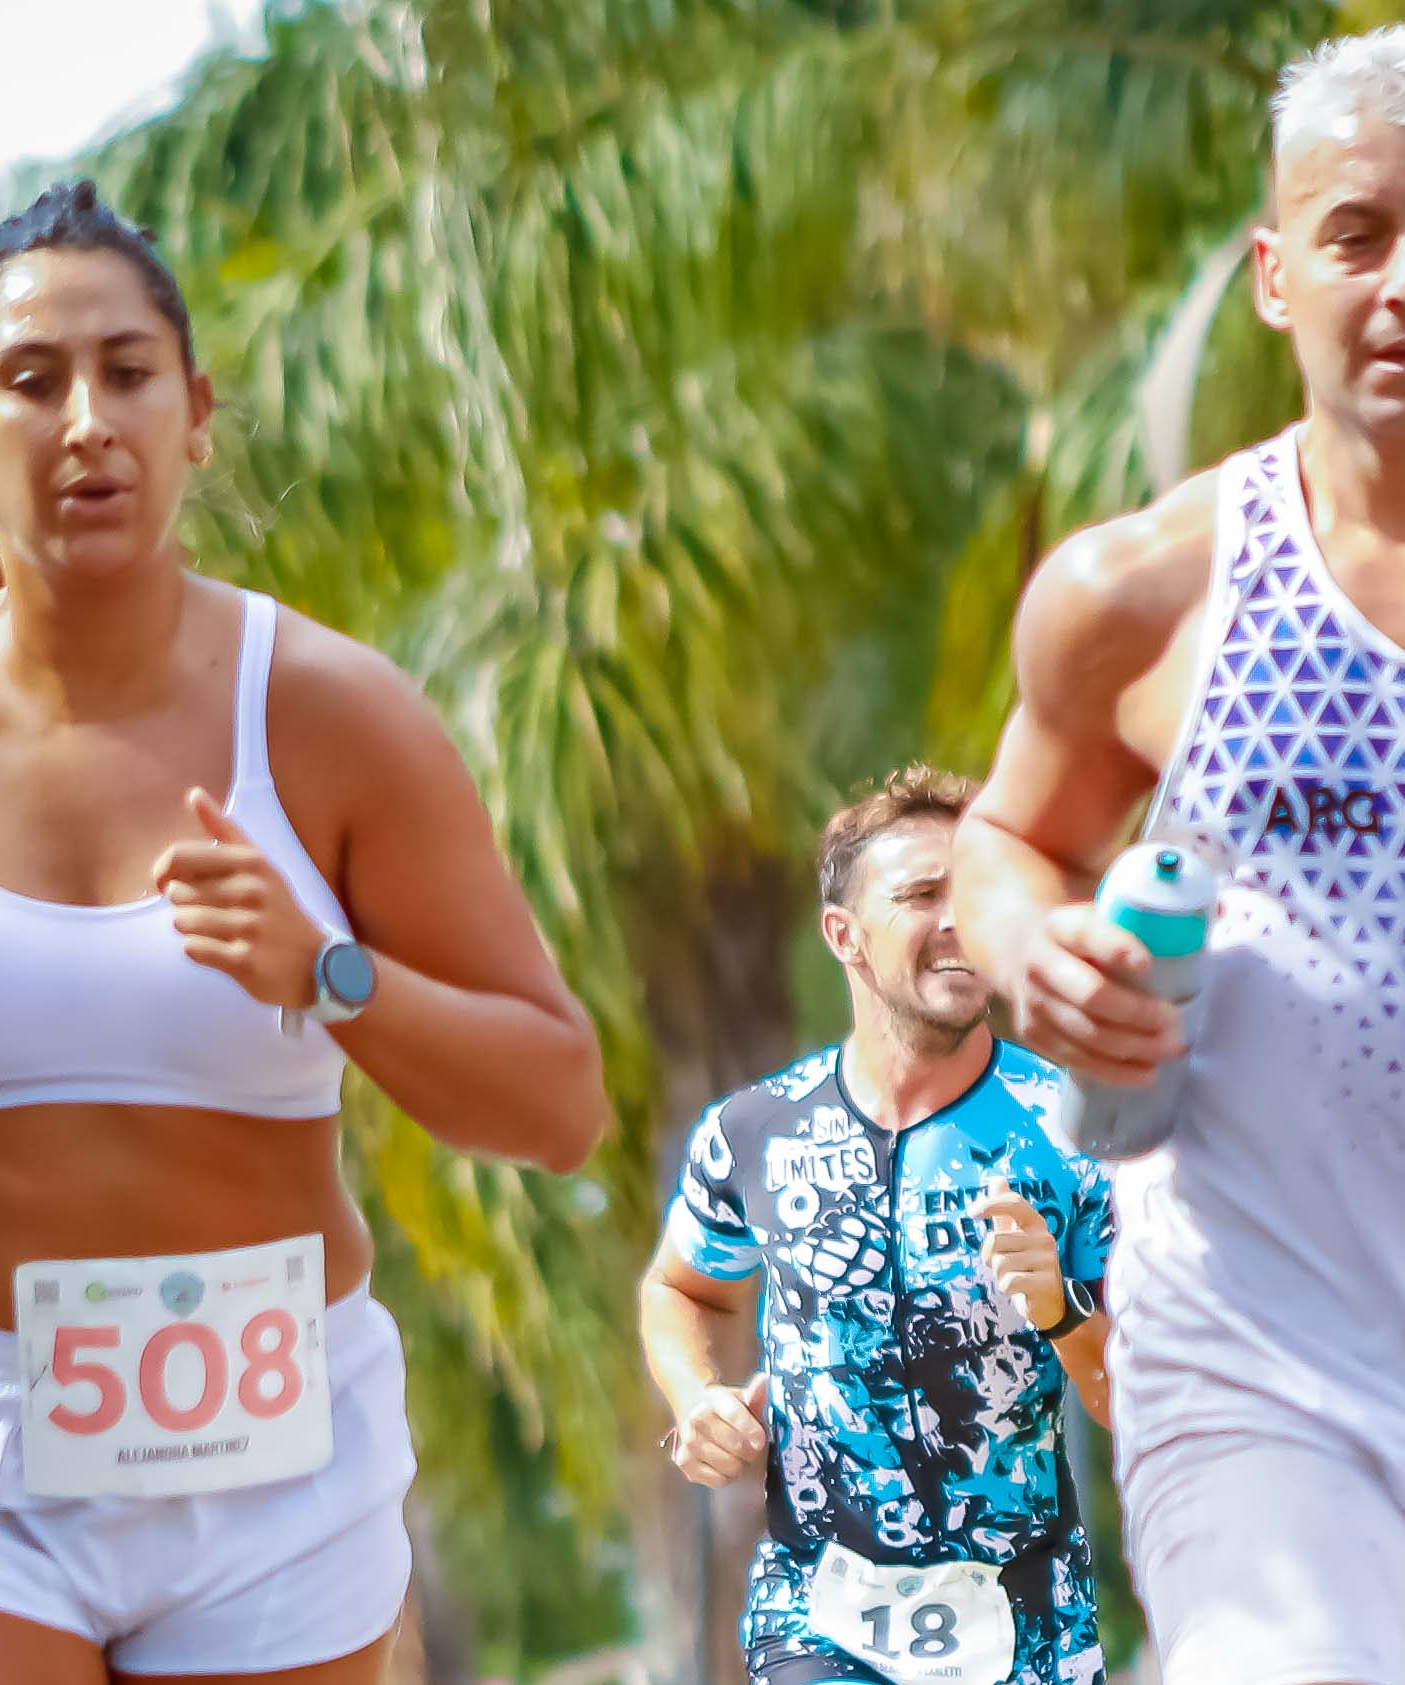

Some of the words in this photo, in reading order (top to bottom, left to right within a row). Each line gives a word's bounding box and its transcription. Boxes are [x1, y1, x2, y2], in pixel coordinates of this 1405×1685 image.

[1264, 786, 1381, 834] ARG
[816, 1116, 846, 1139] SIN
[768, 1147, 874, 1189] LIMITES
[924, 1179, 1061, 1215] ENTNA
[925, 1206, 1066, 1257] DUO
[47, 1307, 304, 1437] 508
[860, 1602, 960, 1659] 18
